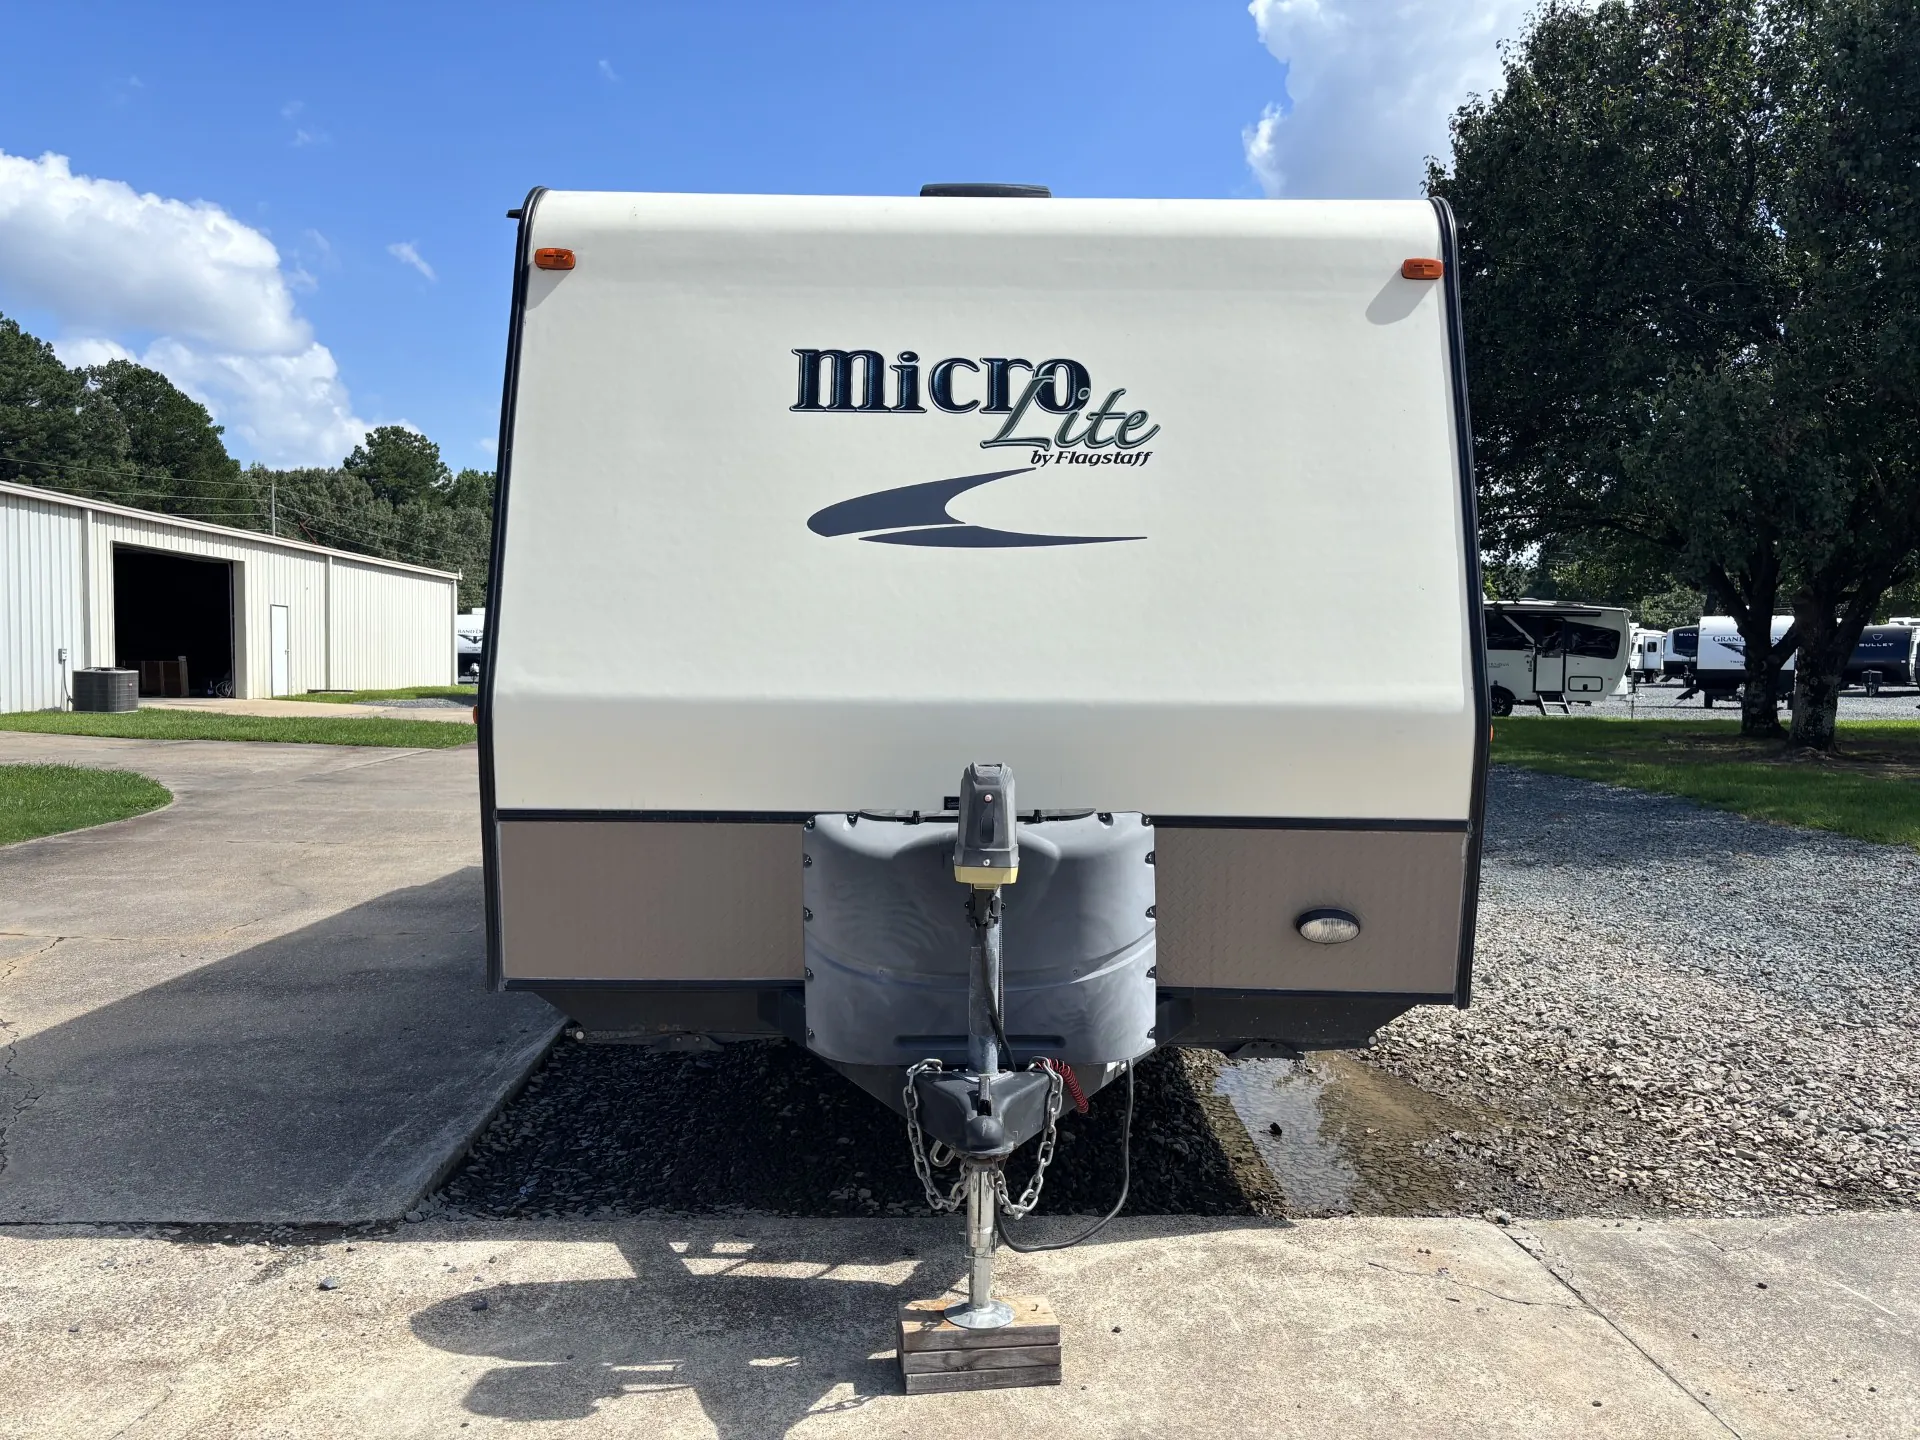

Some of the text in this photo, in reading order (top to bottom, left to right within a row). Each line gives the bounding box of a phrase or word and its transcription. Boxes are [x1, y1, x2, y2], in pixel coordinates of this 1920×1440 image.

[789, 348, 1091, 414] micro
[980, 374, 1161, 451] Lite
[1030, 450, 1153, 467] by Flagstaff
